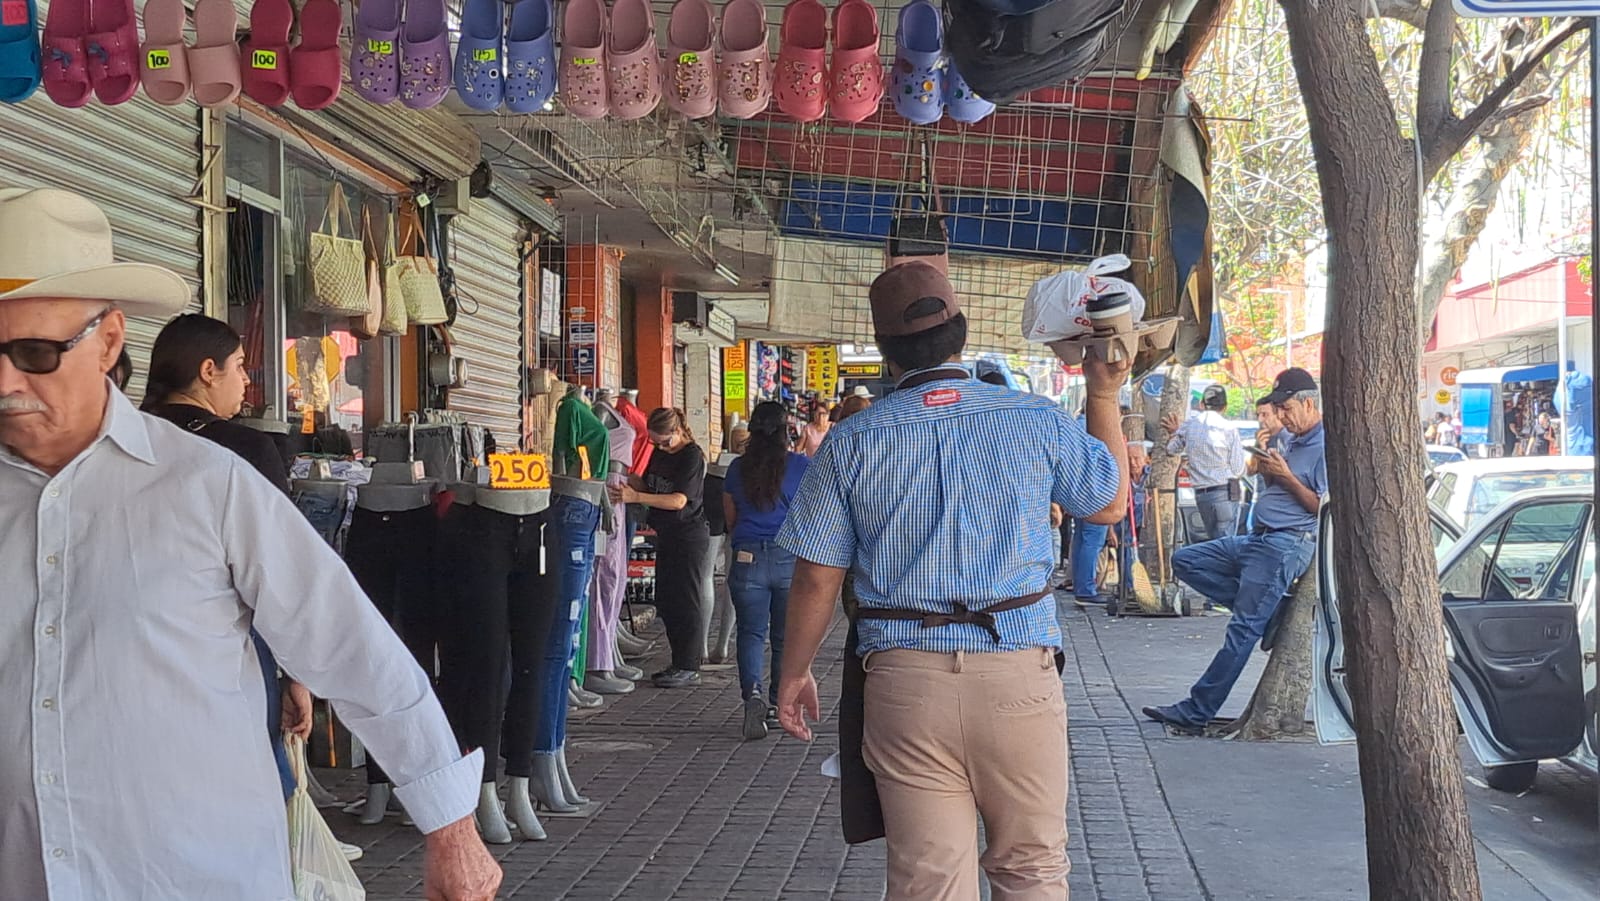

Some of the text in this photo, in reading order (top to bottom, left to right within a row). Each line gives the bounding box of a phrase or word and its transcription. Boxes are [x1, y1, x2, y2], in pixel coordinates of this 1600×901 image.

[150, 53, 169, 67] 100
[253, 52, 275, 65] 100
[493, 460, 544, 482] 250
